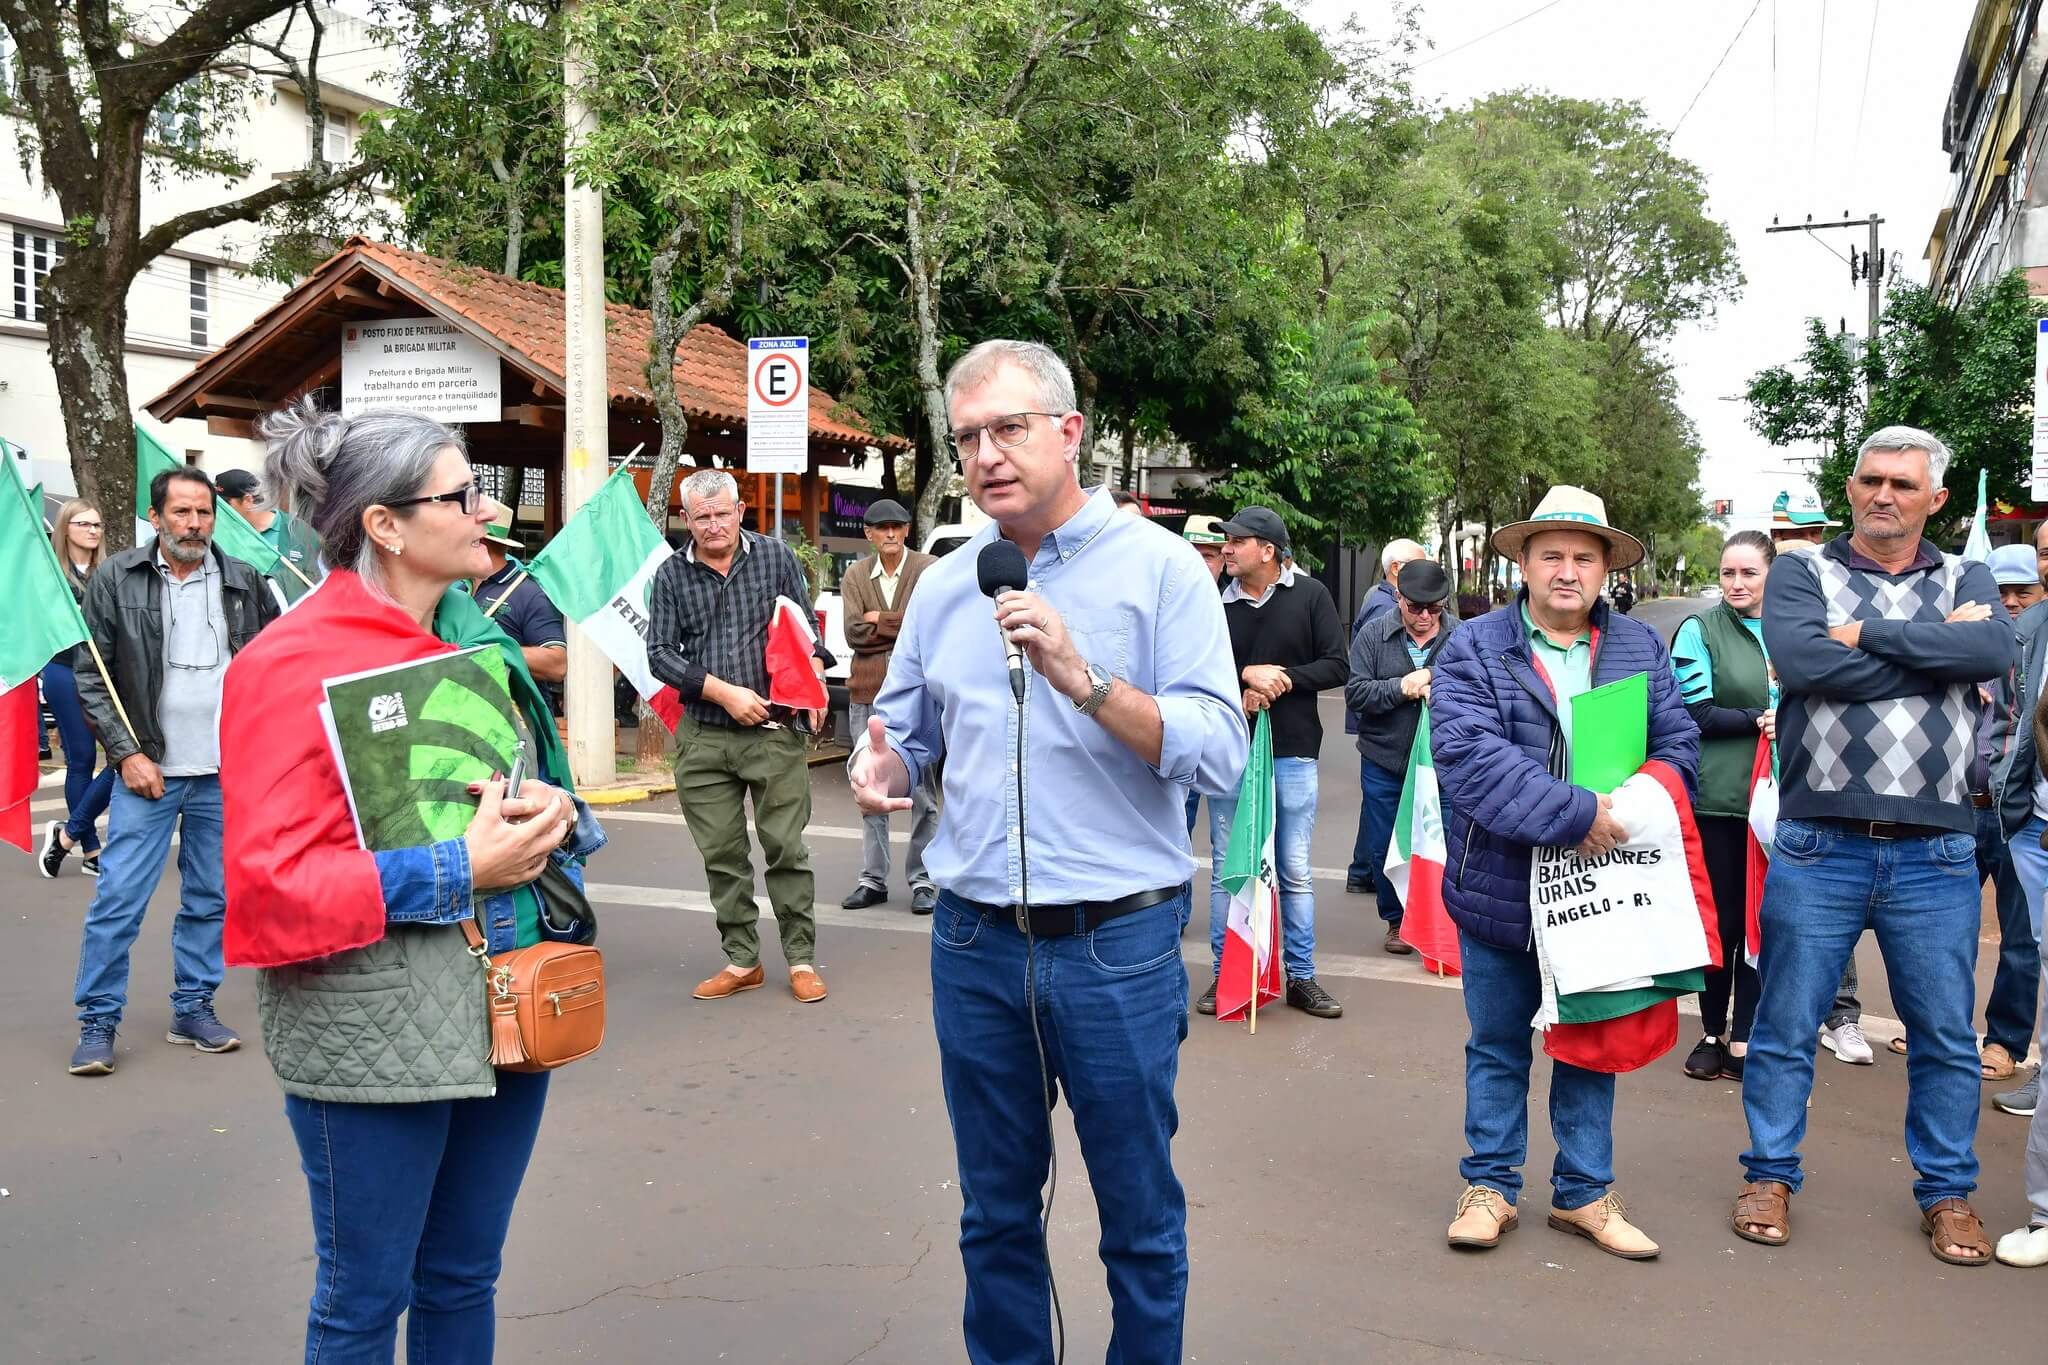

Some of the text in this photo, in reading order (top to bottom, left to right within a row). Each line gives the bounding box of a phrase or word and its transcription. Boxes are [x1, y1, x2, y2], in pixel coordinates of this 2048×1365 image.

[362, 328, 386, 339] POSTO
[387, 327, 403, 337] FIXO
[405, 327, 414, 336] DE
[383, 341, 456, 354] DA BRIGADA MILITAR
[758, 340, 798, 349] ZONA AZUL
[368, 368, 406, 377] Prefeitura
[415, 367, 446, 377] Brigada
[447, 366, 473, 374] Militar
[364, 378, 478, 391] trabalhando em parceria
[769, 364, 786, 395] E
[345, 396, 362, 404] para
[364, 394, 393, 405] garantir
[396, 393, 437, 404] segurança
[1538, 874, 1597, 905] URAIS
[1547, 898, 1611, 928] ÂNGELO
